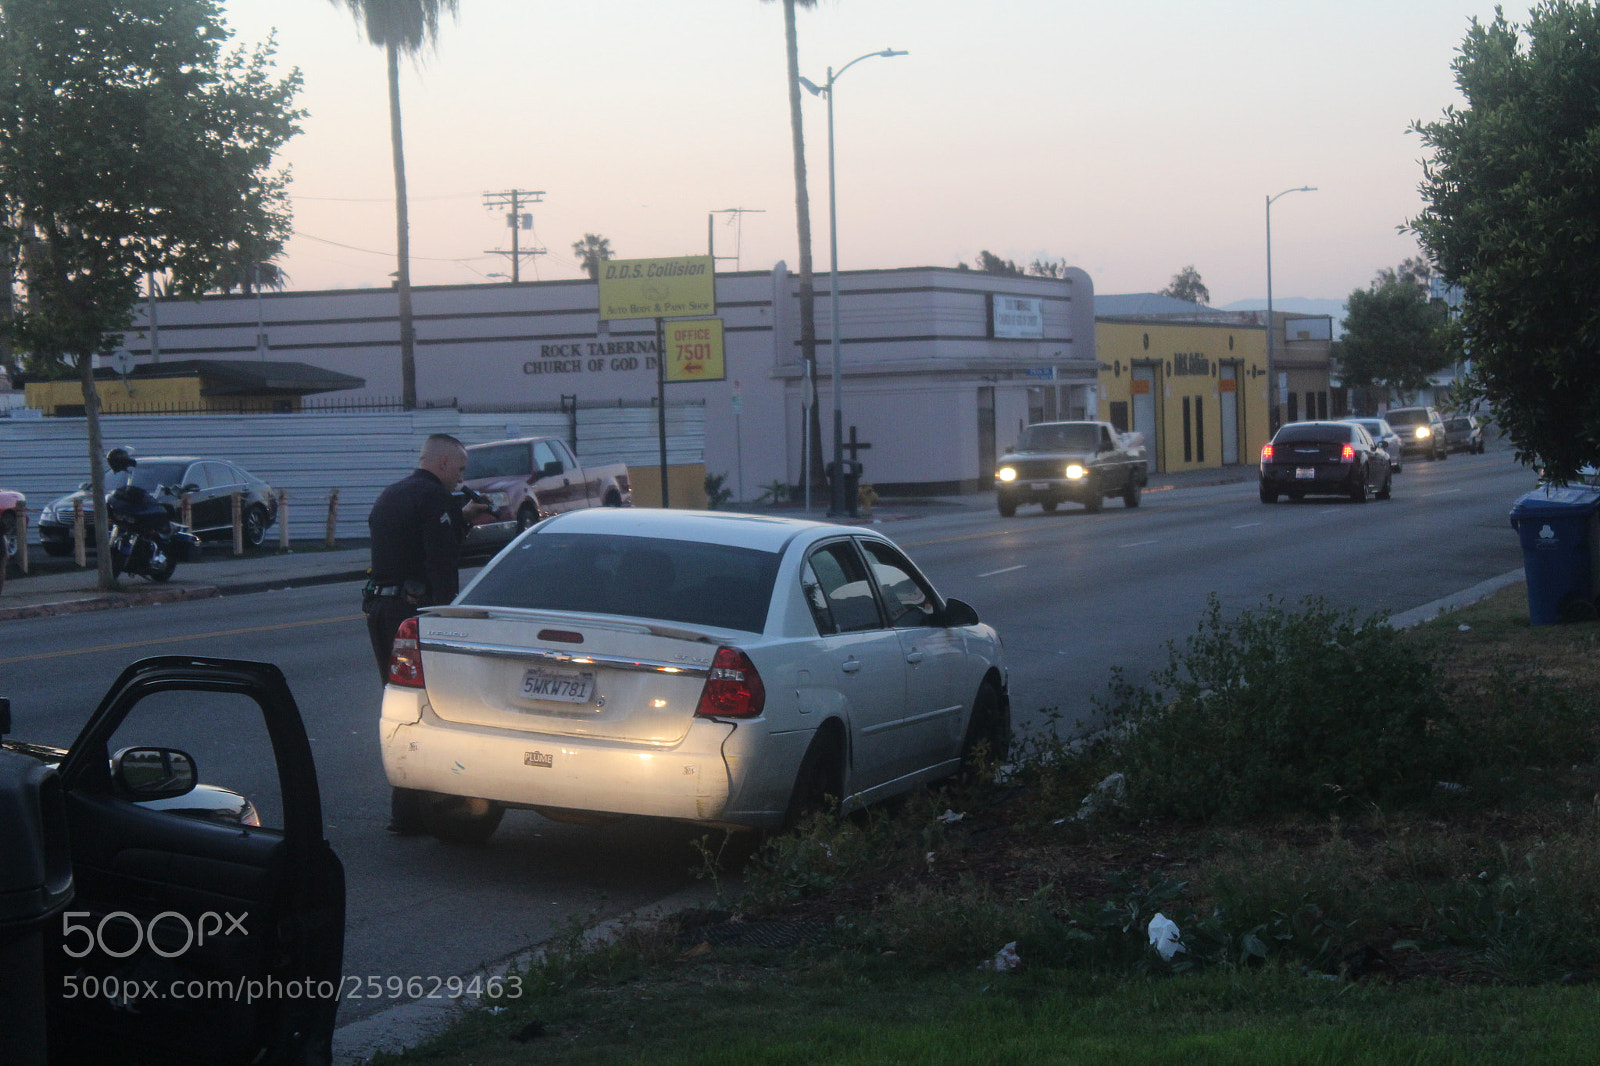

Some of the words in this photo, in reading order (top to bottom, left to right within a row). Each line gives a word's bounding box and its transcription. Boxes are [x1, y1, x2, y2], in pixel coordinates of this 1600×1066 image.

[606, 264, 643, 280] D.D.S.
[647, 261, 705, 278] Collision
[674, 329, 711, 342] OFFICE
[541, 343, 581, 357] ROCK
[587, 341, 658, 356] TABERNA
[676, 343, 711, 362] 7501
[523, 360, 581, 374] CHURCH
[587, 359, 604, 372] OF
[610, 358, 638, 371] GOD
[524, 677, 586, 698] 5WKW781
[524, 753, 552, 764] PLUME
